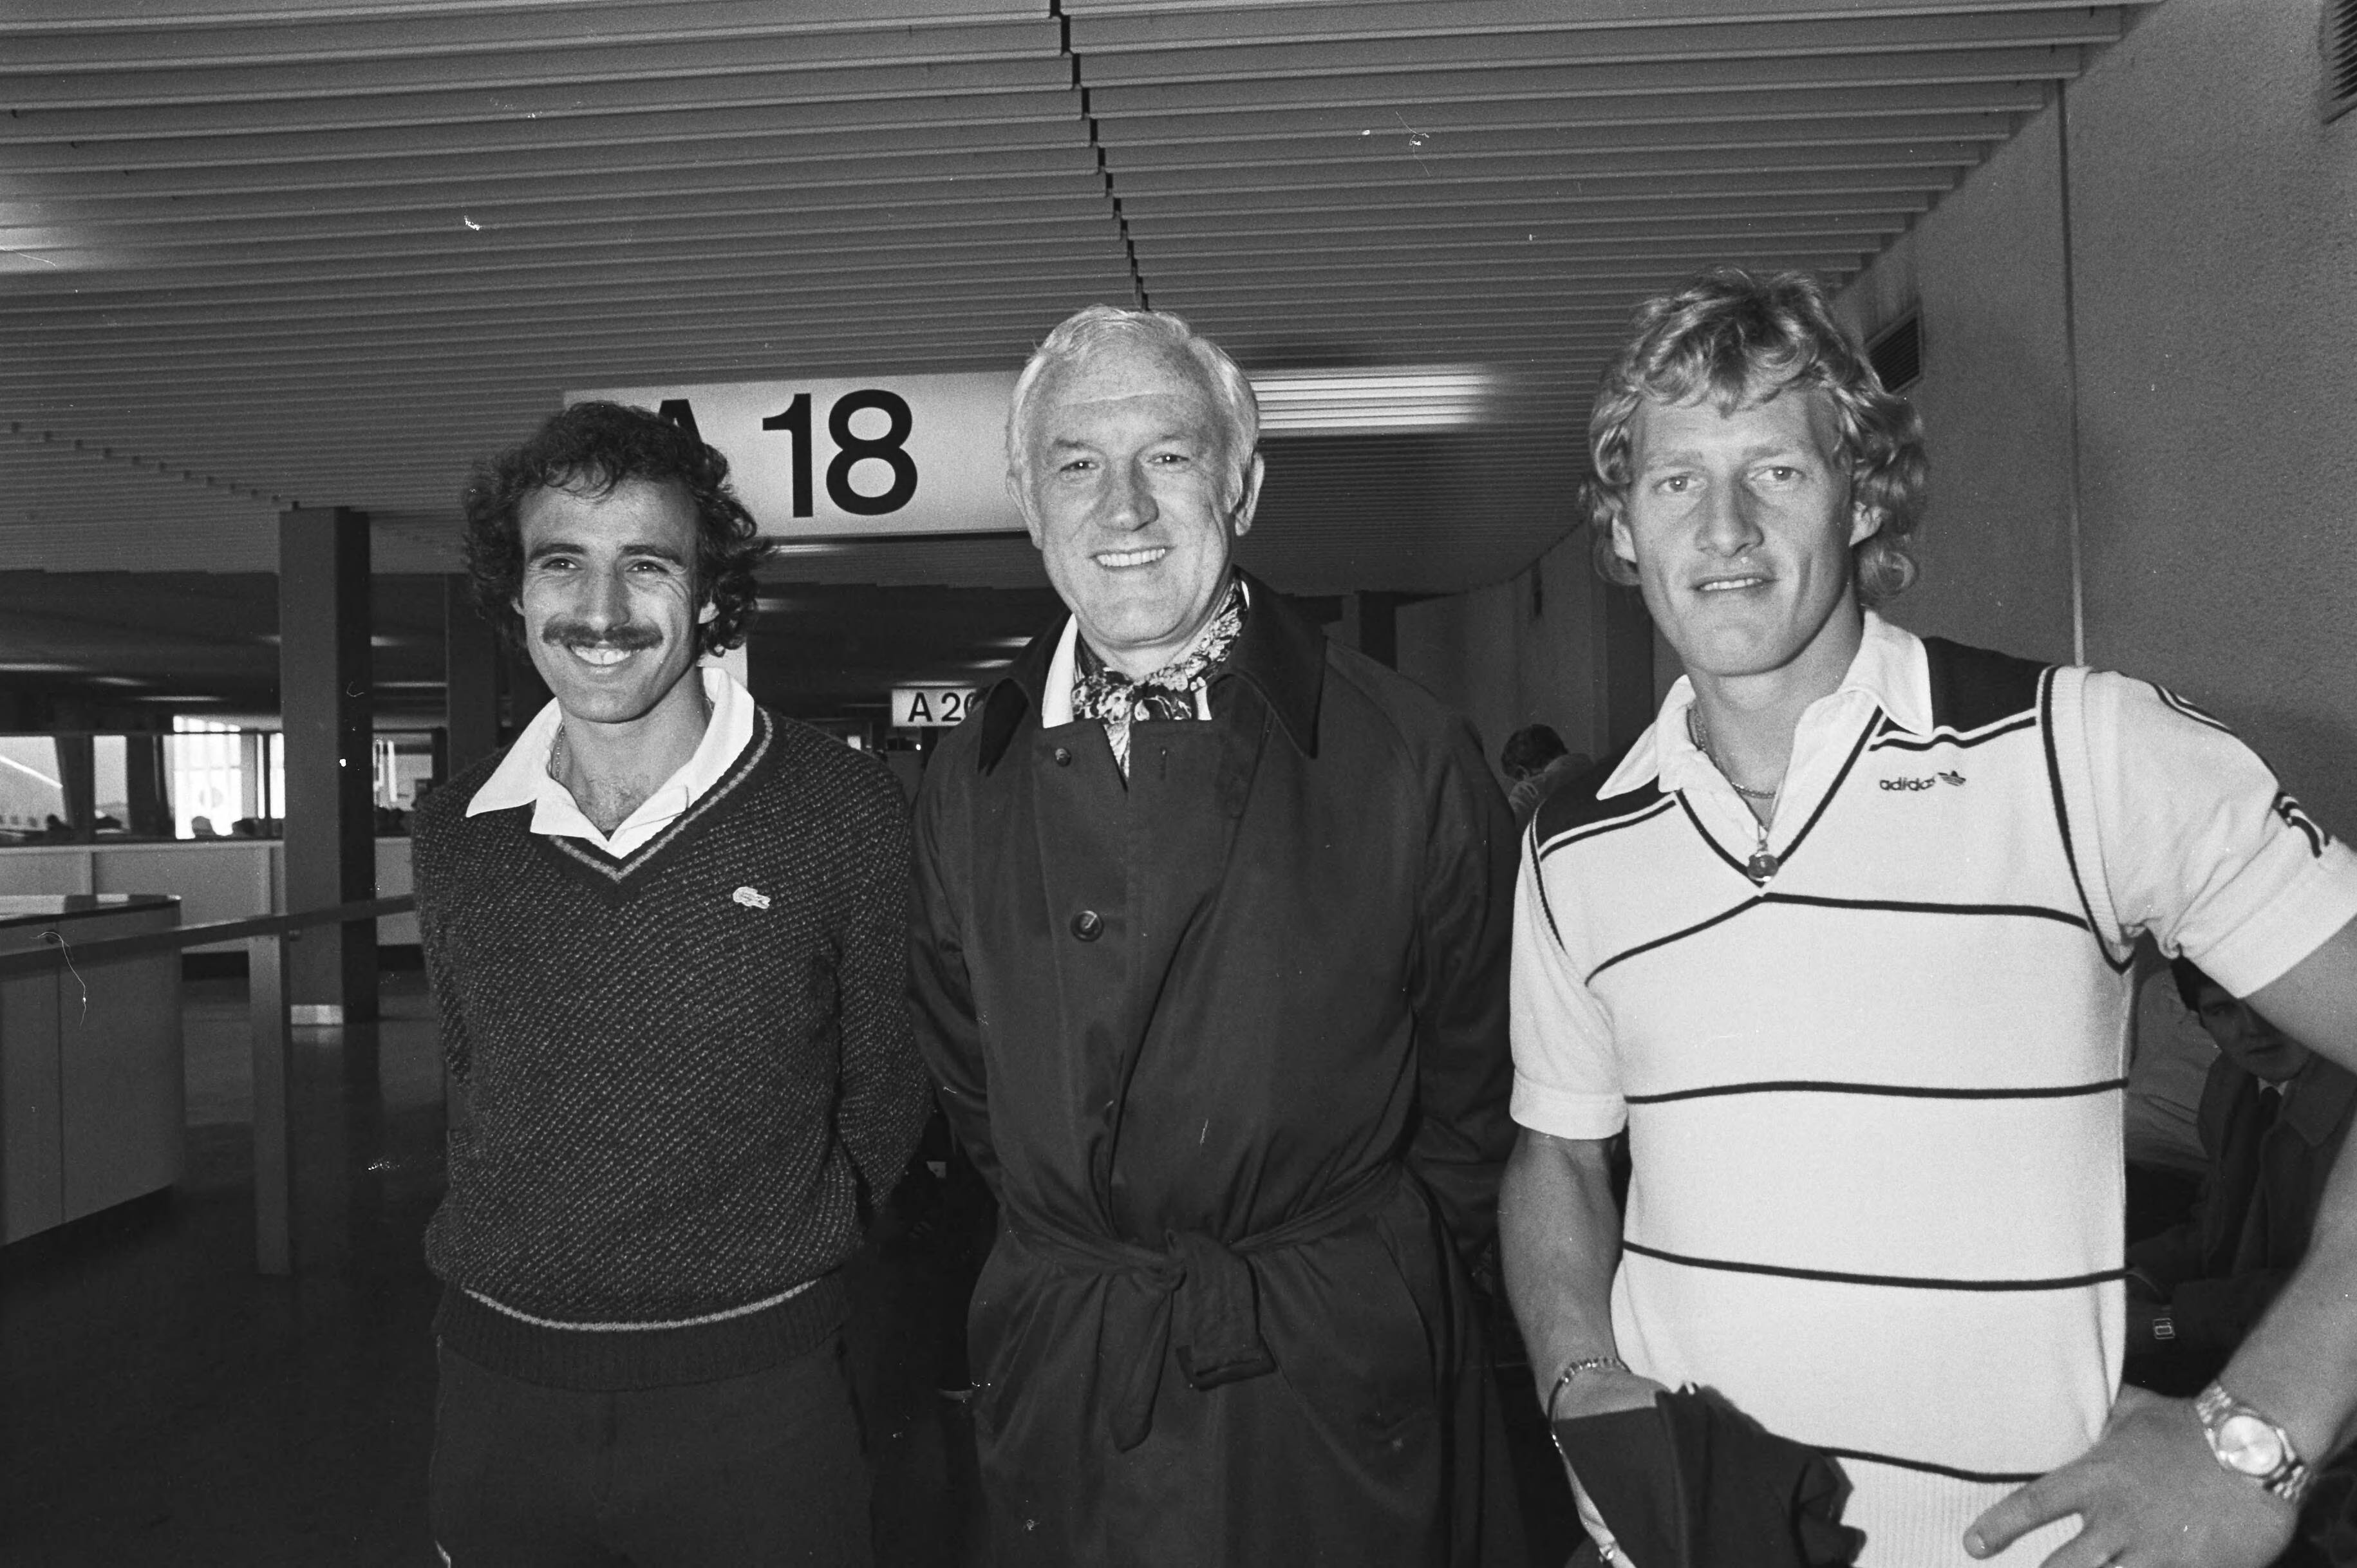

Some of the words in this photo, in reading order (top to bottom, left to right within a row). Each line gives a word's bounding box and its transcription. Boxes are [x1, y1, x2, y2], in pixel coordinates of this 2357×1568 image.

[762, 389, 917, 518] 18
[908, 692, 932, 722] A
[1880, 776, 1935, 790] adidas
